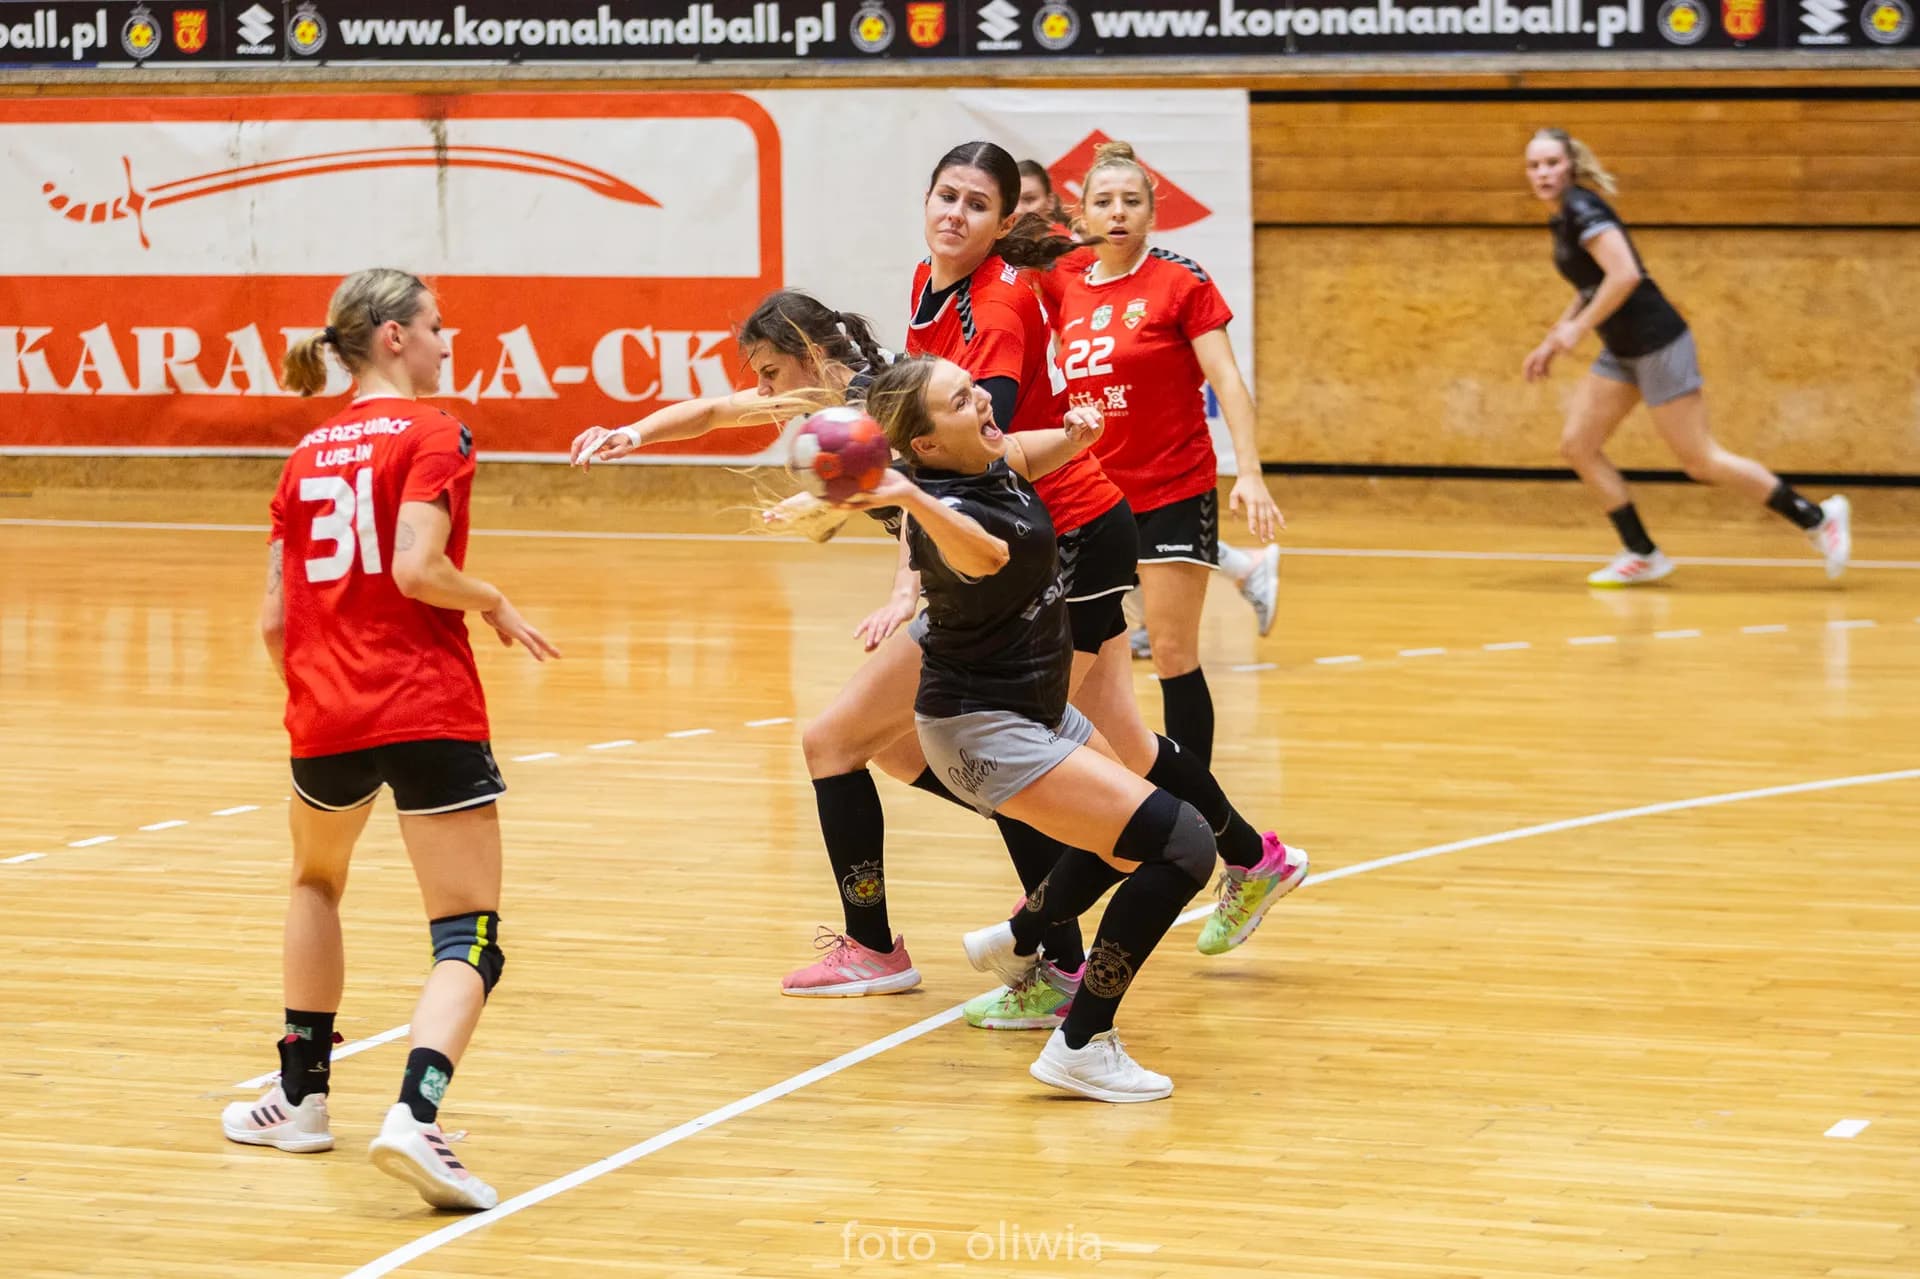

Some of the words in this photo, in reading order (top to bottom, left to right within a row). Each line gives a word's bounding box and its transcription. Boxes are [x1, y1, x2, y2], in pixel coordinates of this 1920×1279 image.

[339, 2, 836, 56] www.koronahandball.pl
[1091, 0, 1643, 48] www.koronahandball.pl
[0, 321, 737, 405] KARABLA-CK
[1065, 335, 1115, 380] 22
[315, 443, 374, 468] LUBLIN
[299, 466, 382, 584] 31
